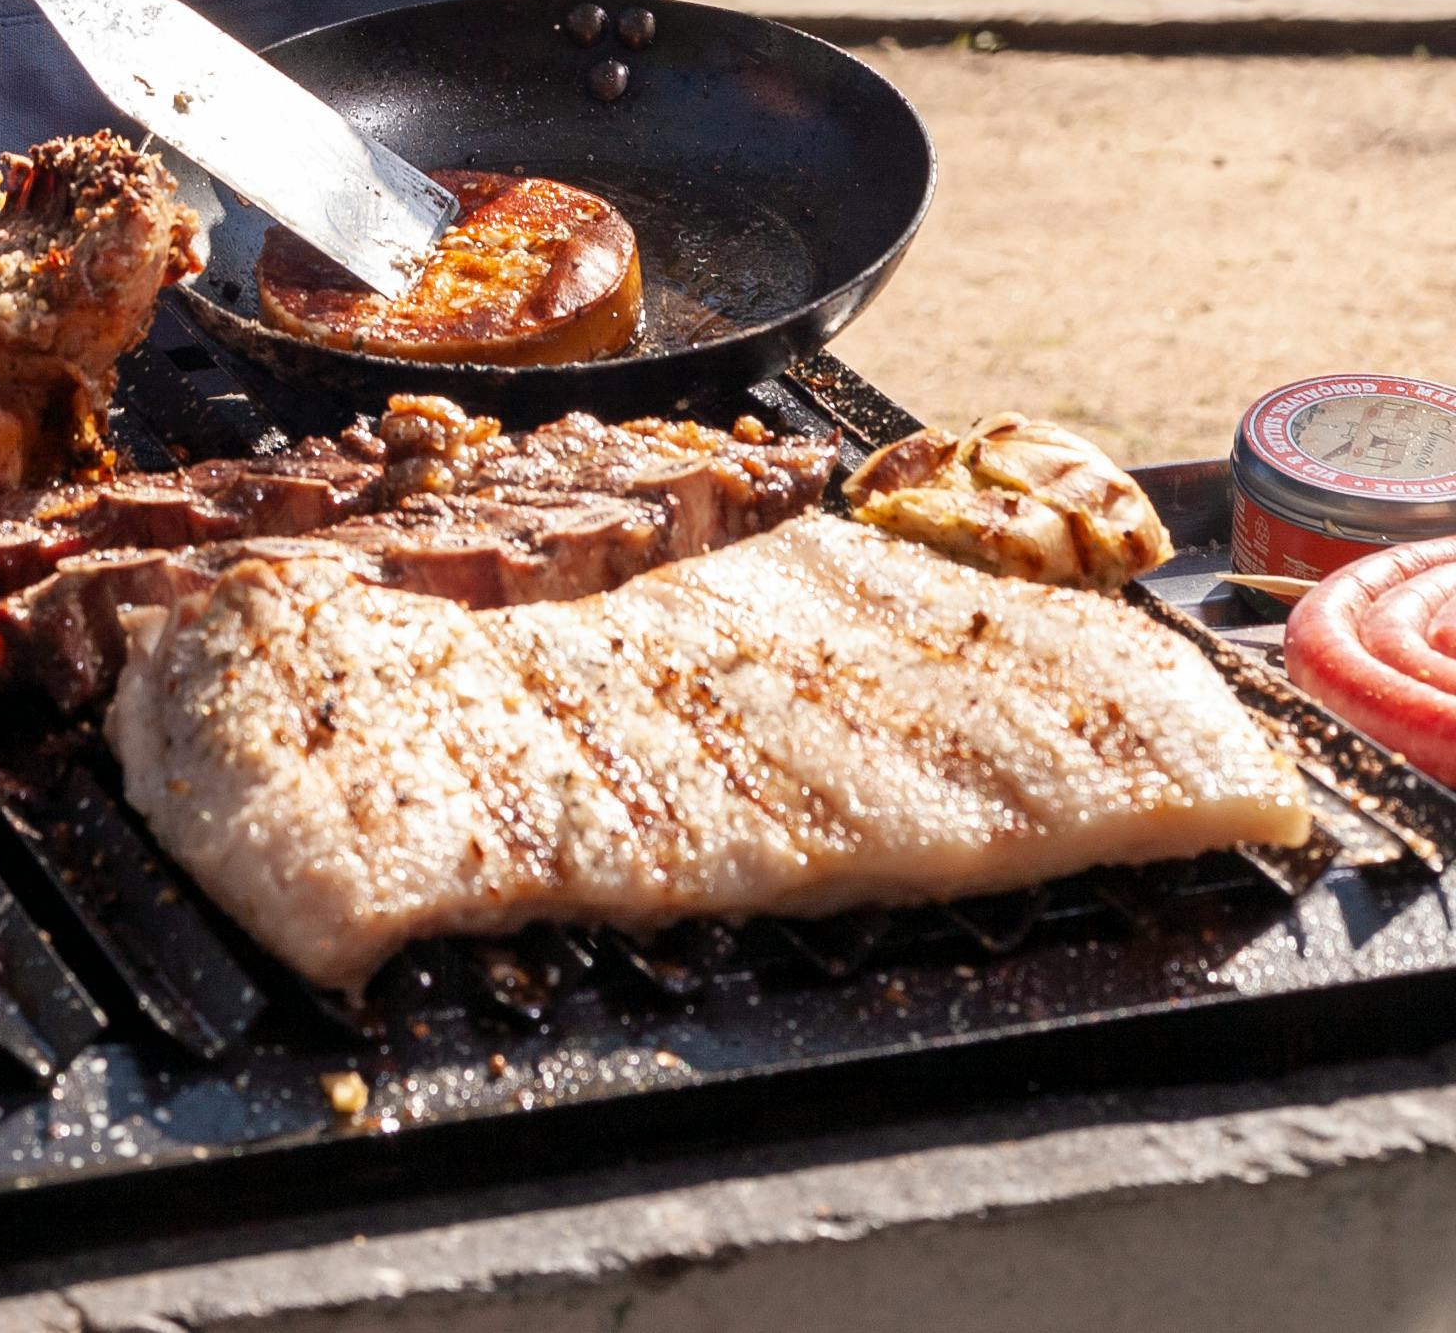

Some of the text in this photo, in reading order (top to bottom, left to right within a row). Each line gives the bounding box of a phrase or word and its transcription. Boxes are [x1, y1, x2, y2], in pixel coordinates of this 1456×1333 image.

[1263, 416, 1293, 453] SALLES
[1286, 456, 1304, 466] &
[1299, 464, 1339, 482] CIA
